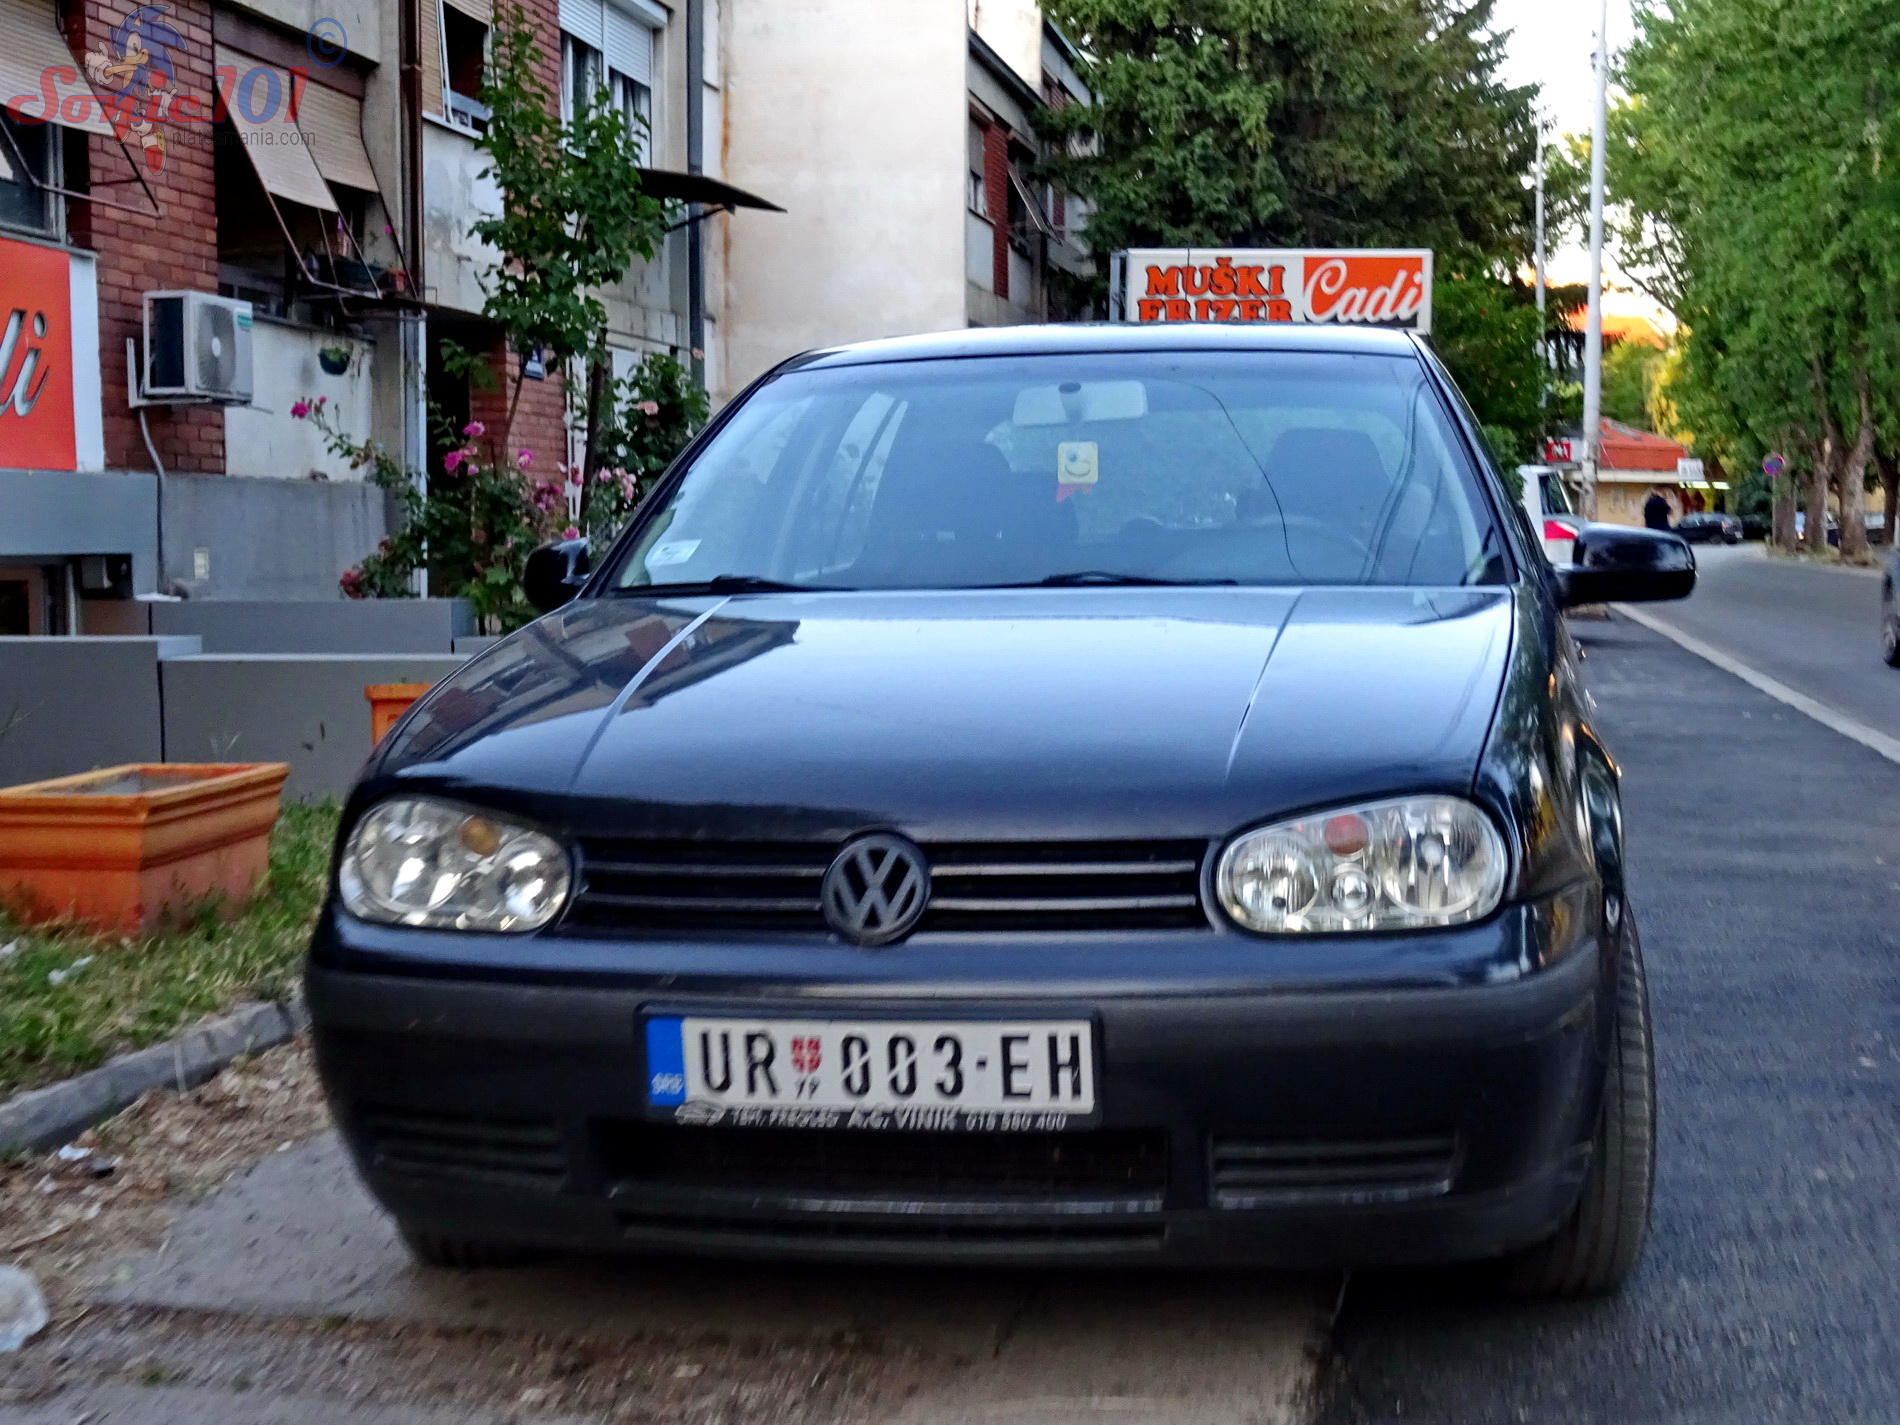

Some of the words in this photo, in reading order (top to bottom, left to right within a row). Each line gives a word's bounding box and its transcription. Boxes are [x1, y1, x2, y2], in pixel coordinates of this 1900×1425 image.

[1144, 257, 1286, 297] MUŠKI
[1302, 258, 1423, 323] Cadi
[1137, 299, 1293, 322] FRIZER
[701, 1031, 779, 1096] UR
